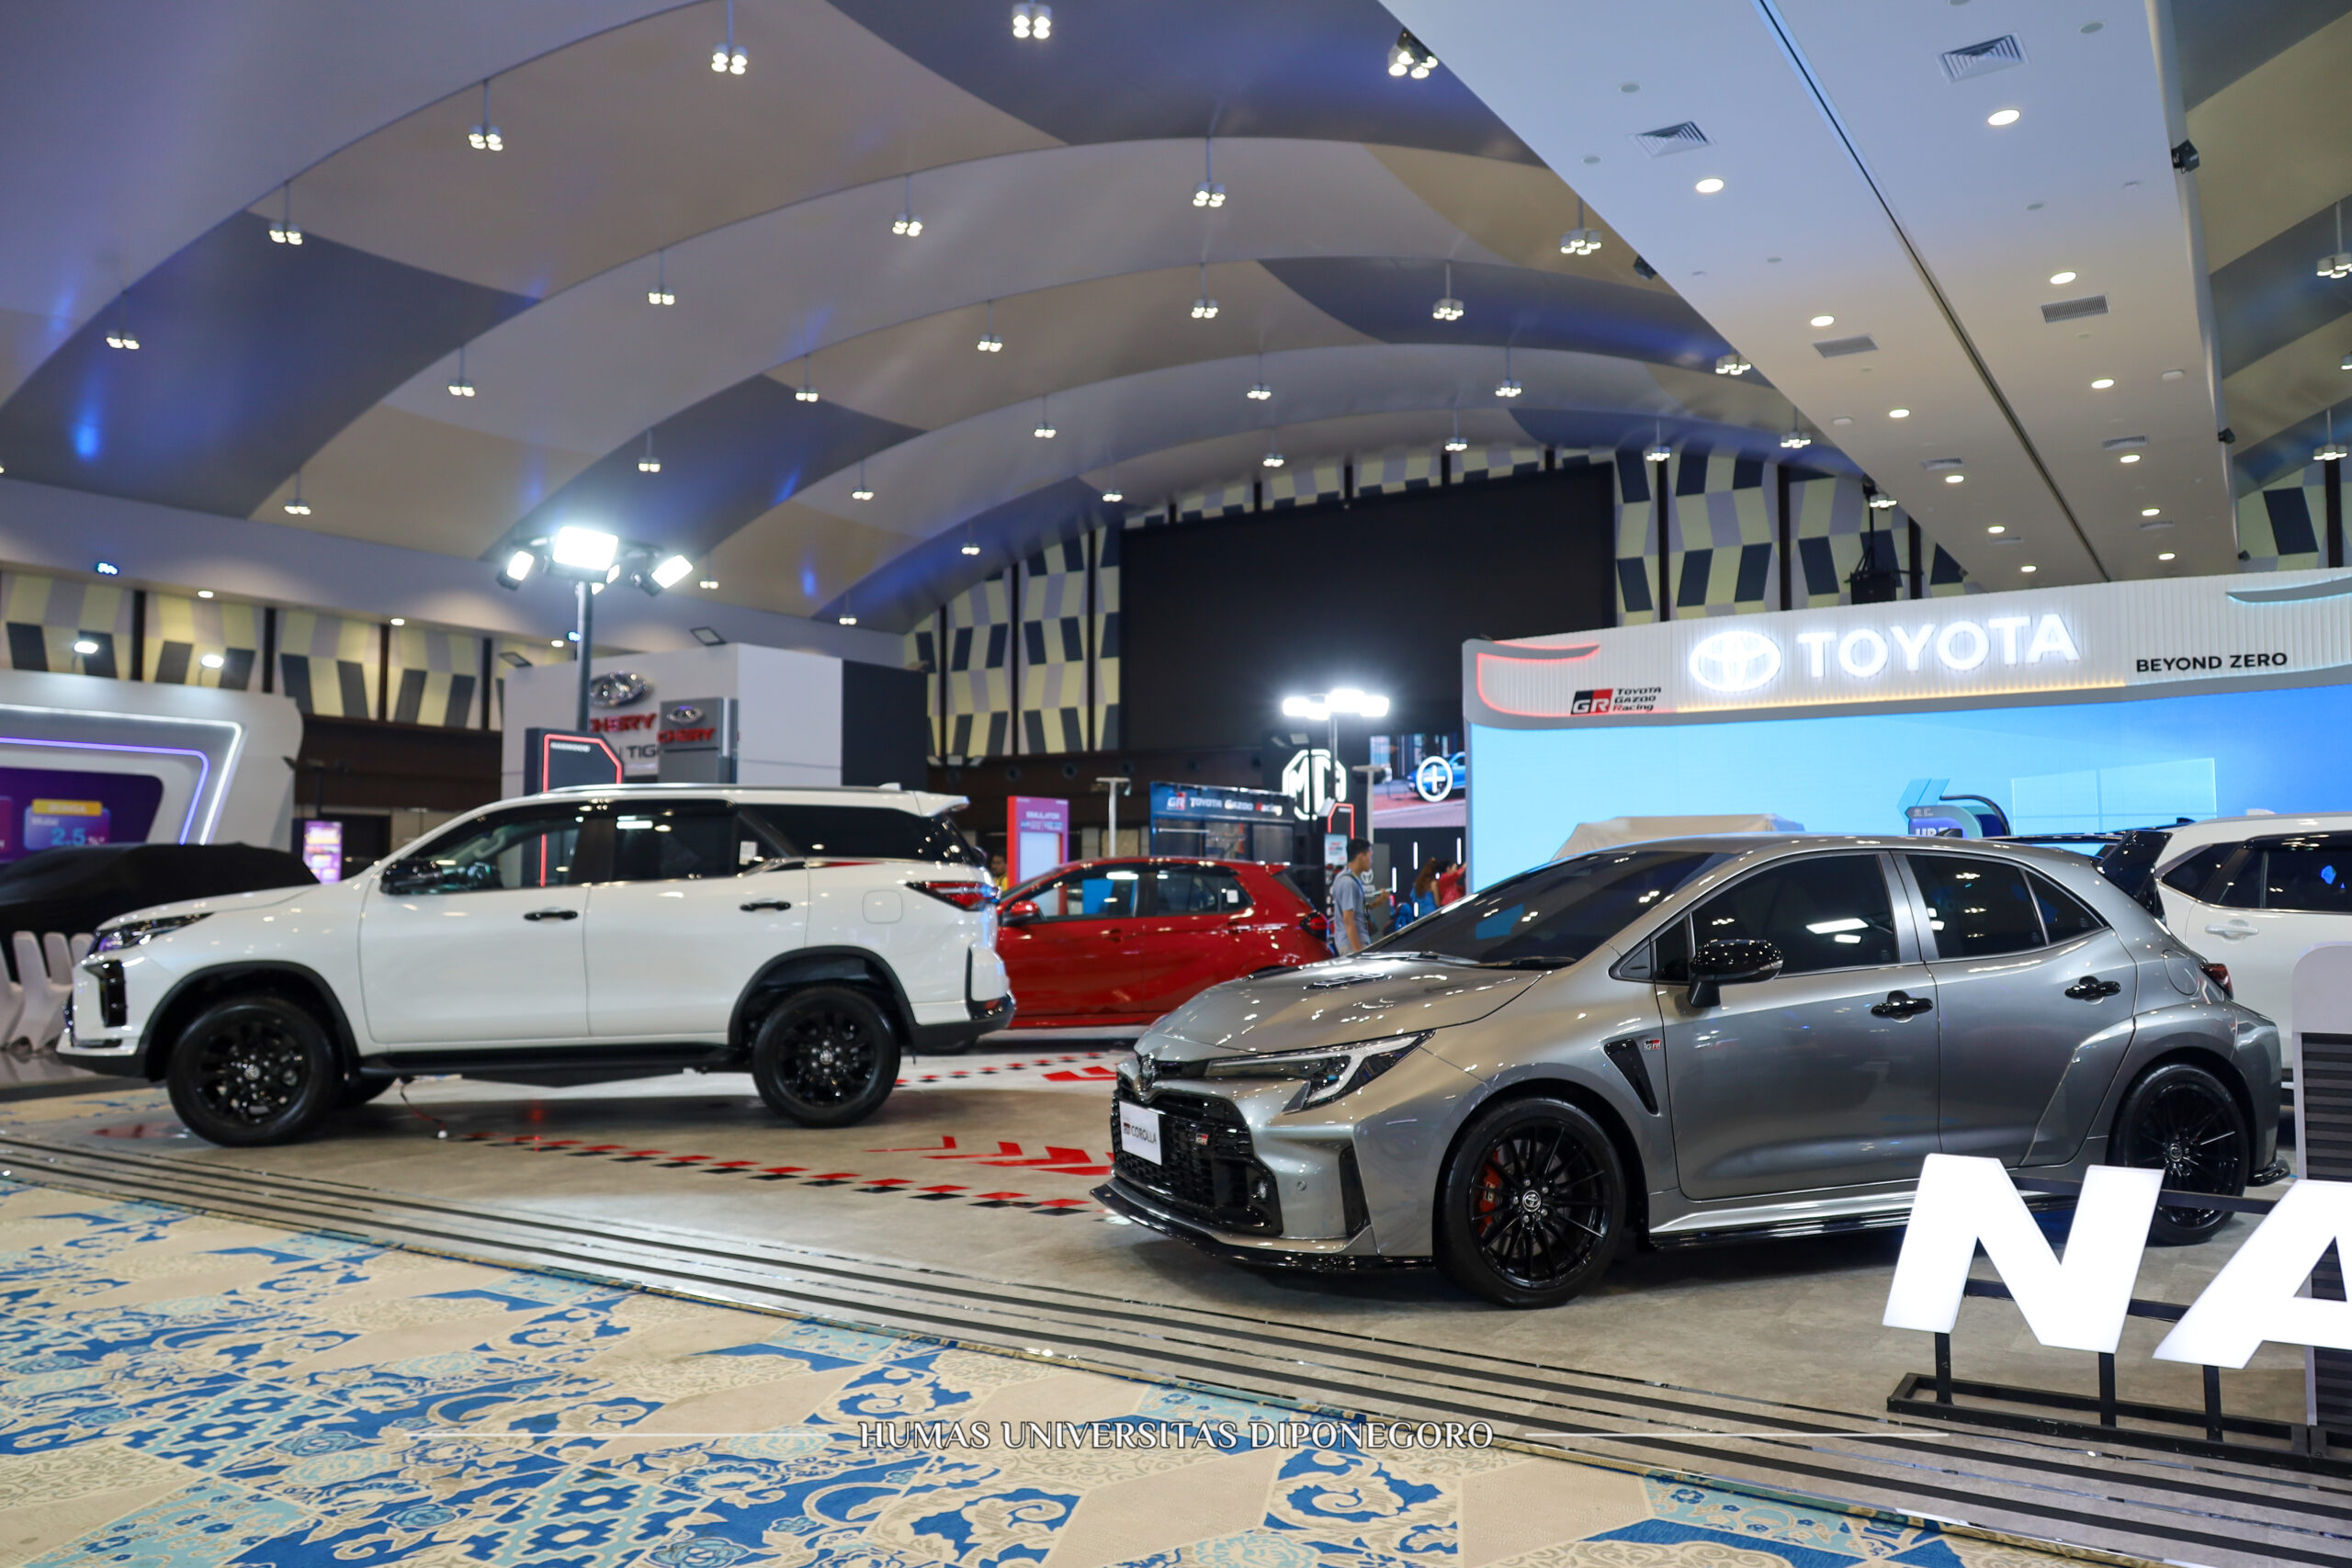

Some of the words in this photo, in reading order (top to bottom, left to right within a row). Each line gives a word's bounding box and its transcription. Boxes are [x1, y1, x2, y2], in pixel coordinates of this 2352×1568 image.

[1796, 613, 2081, 679] TOYOTA
[2136, 656, 2222, 673] BEYOND
[2229, 652, 2288, 669] ZERO
[1614, 694, 1657, 704] GAZOO
[1617, 686, 1661, 695] TOYOTA
[1572, 698, 1611, 715] GR
[627, 743, 658, 759] TIG
[1284, 751, 1346, 818] MG
[1190, 797, 1222, 808] TOYOTA
[1225, 799, 1254, 811] GAZOO
[1131, 1125, 1158, 1145] COROLLA
